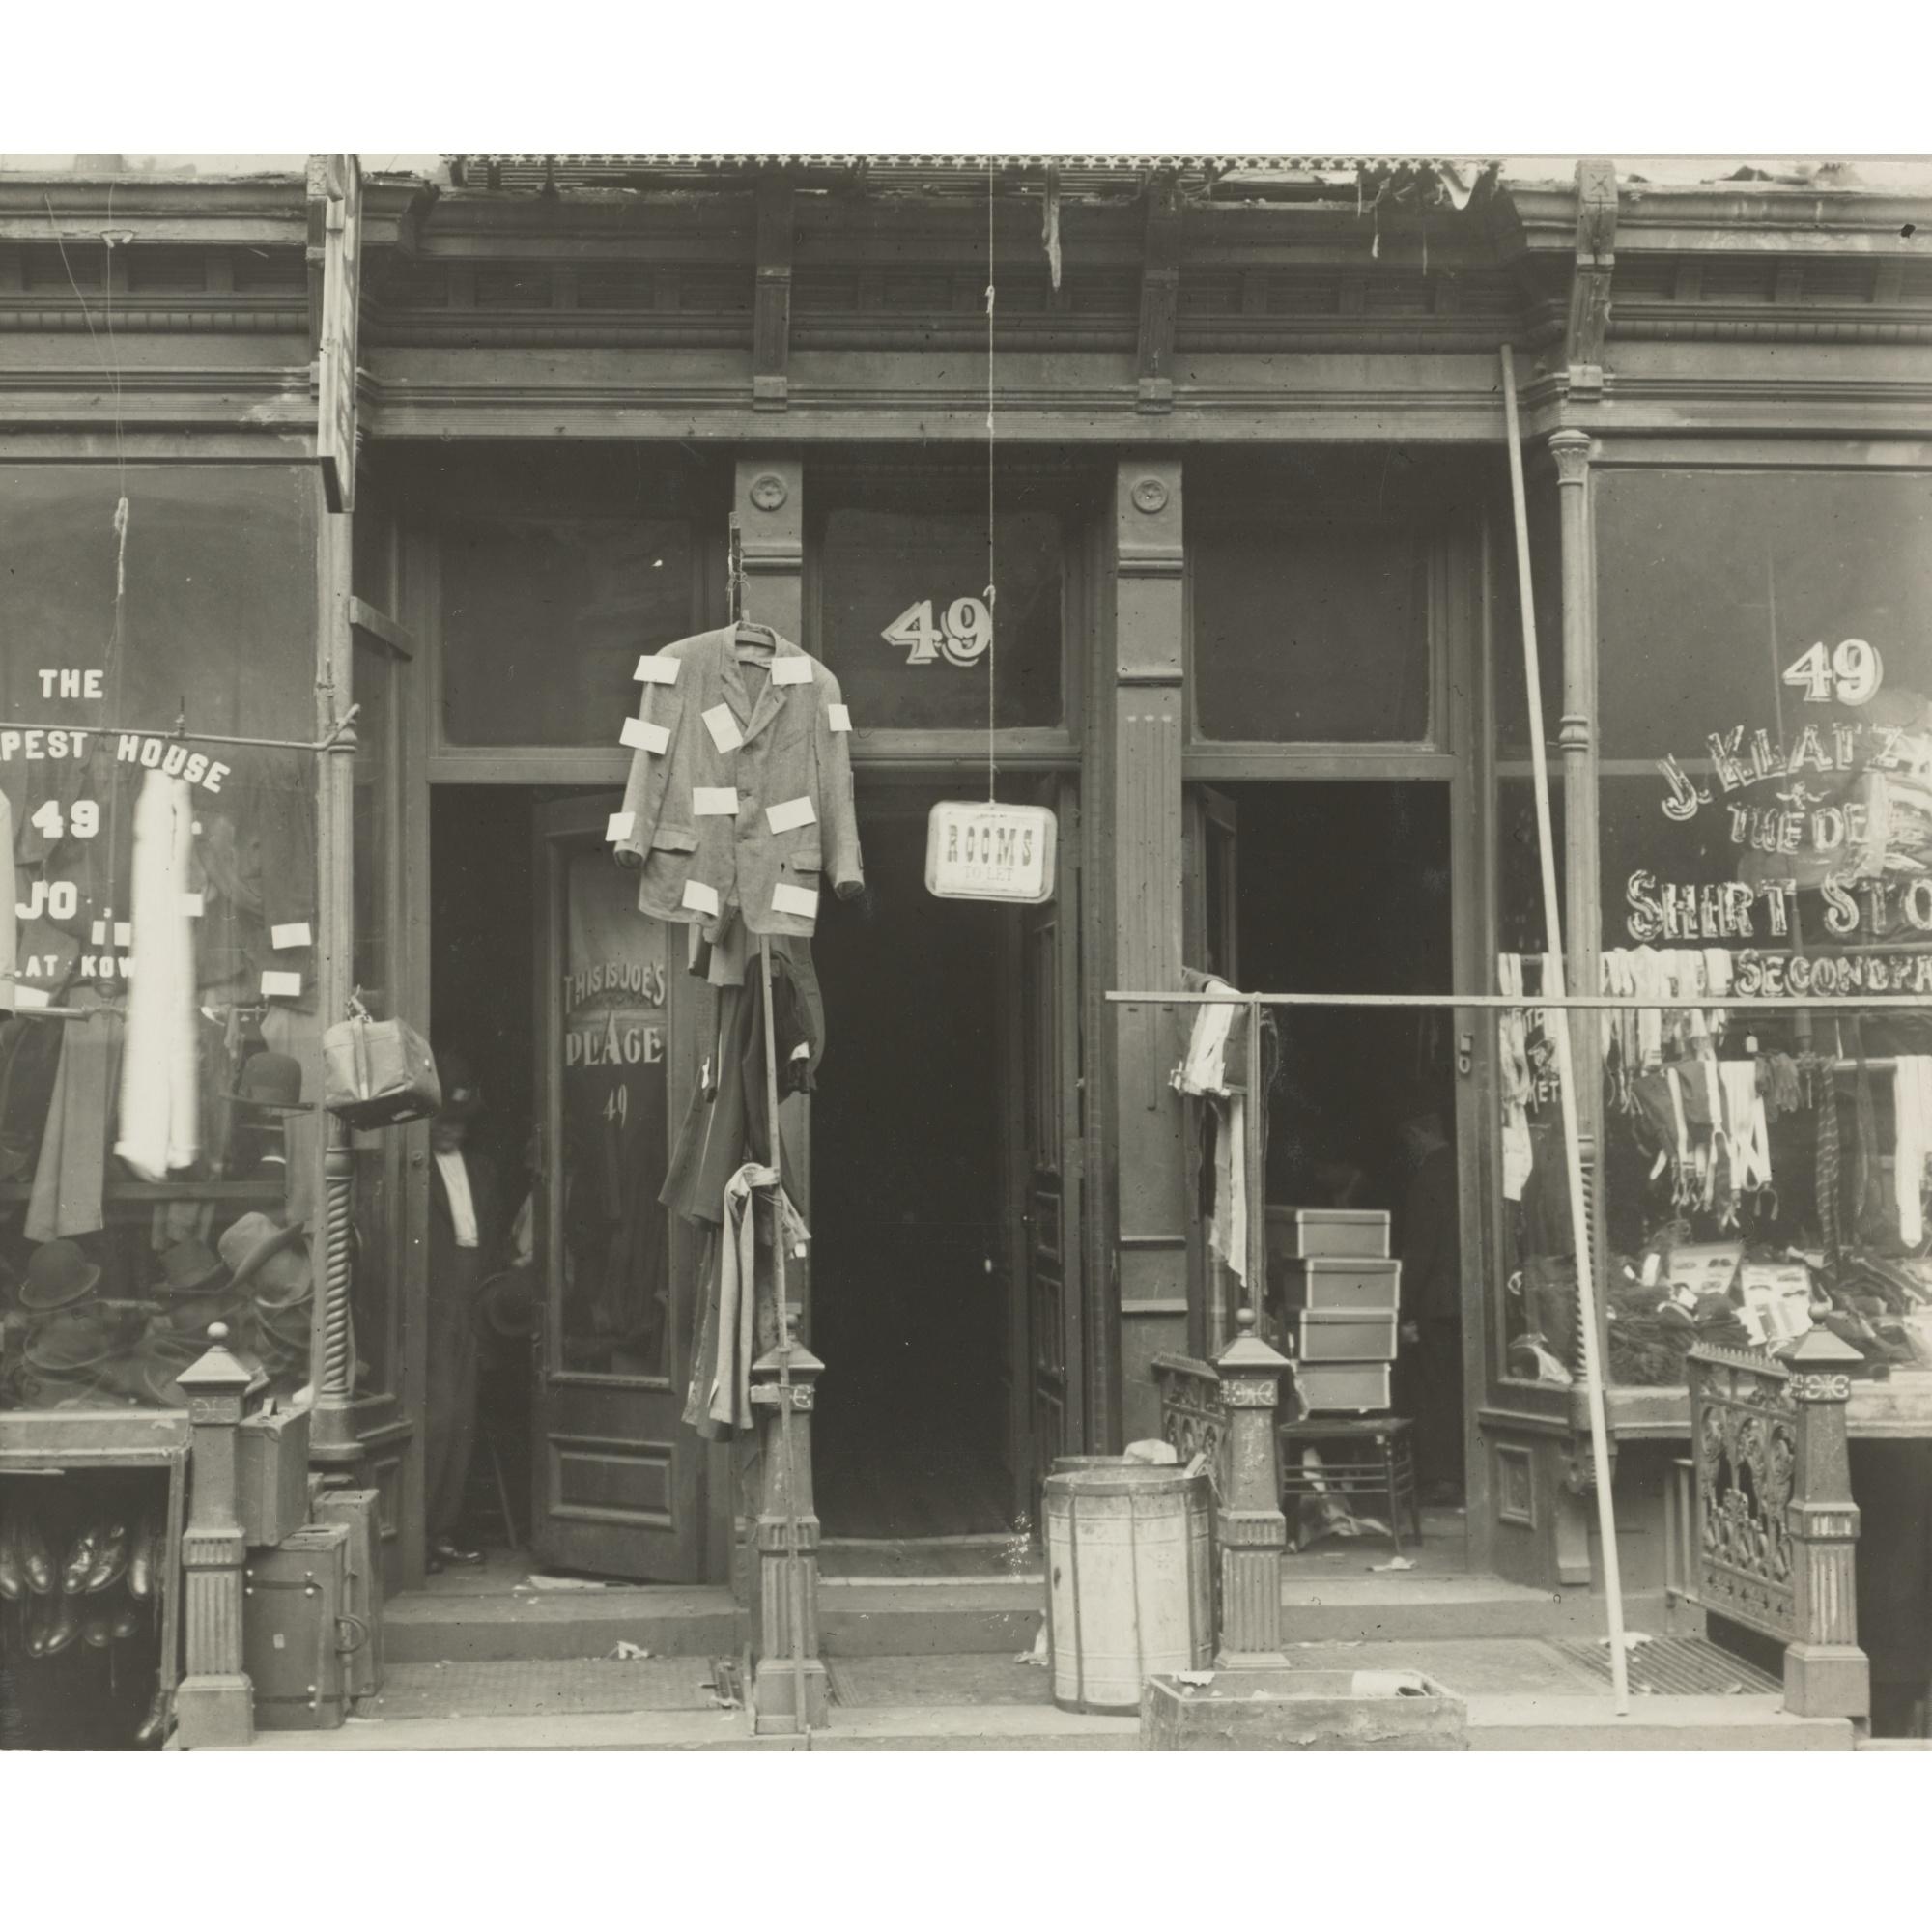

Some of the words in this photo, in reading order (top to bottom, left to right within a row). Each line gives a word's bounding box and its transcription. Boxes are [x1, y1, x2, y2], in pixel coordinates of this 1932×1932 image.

[880, 597, 994, 667] 49
[38, 669, 104, 698] THE
[1782, 639, 1883, 706] 49
[0, 730, 88, 761] PEST
[117, 734, 231, 794] HOUSE
[31, 800, 99, 838] 49
[947, 824, 1033, 867] ROOMS
[564, 965, 601, 1015] THIS
[605, 962, 618, 989] IS
[603, 1083, 628, 1129] 49
